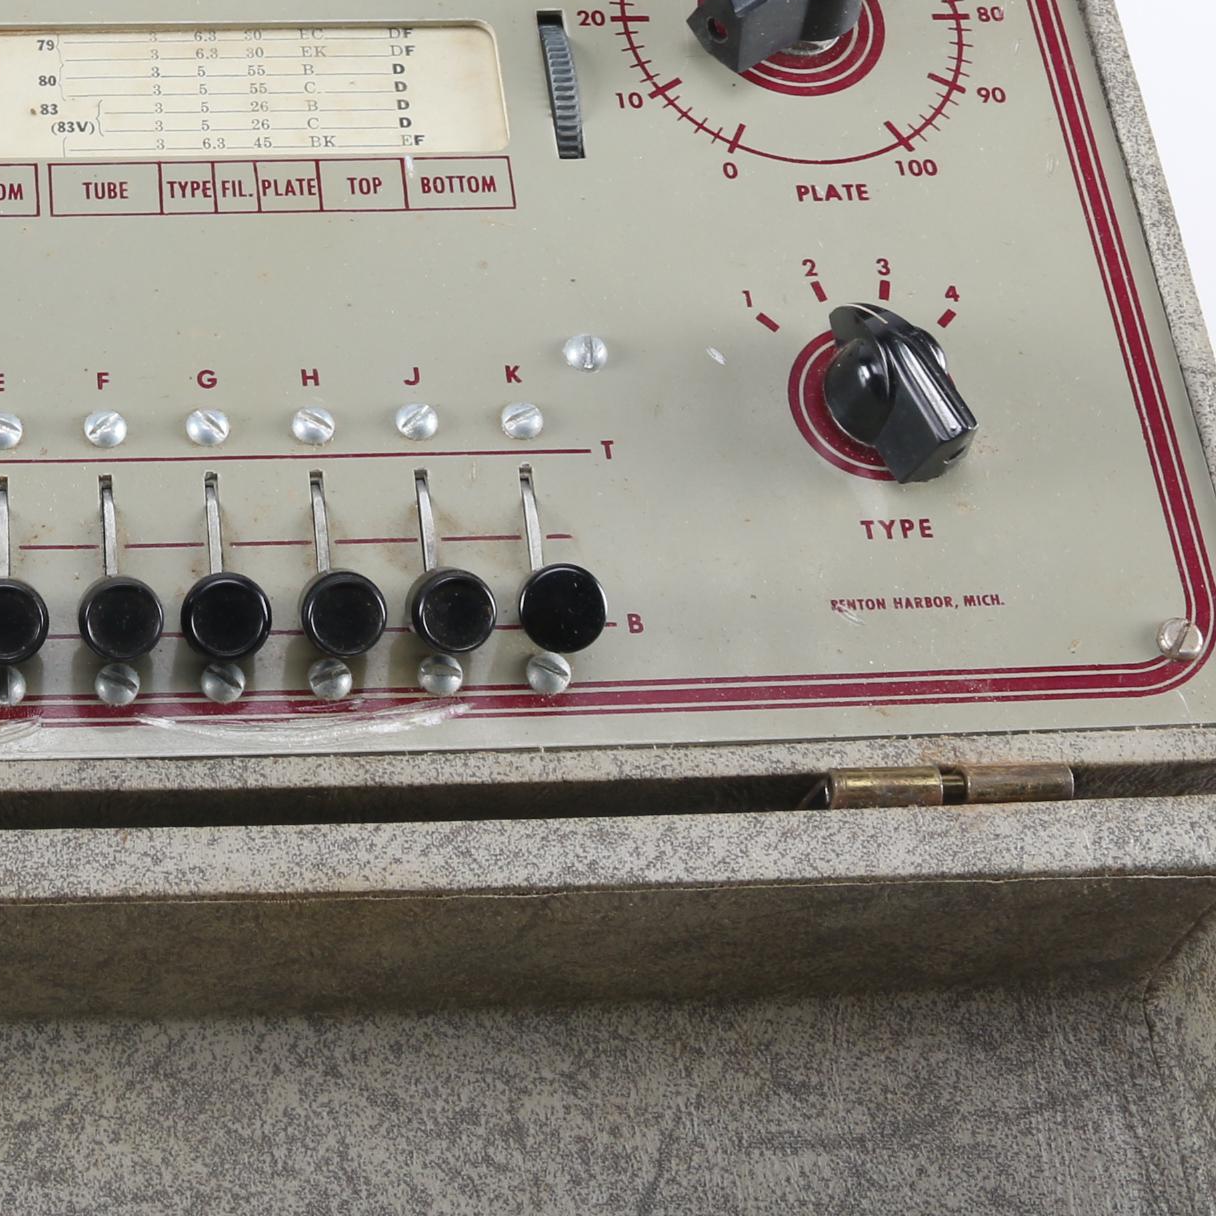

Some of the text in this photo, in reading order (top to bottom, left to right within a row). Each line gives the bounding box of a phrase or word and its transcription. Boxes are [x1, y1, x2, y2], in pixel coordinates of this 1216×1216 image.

[577, 10, 605, 26] 20
[977, 7, 1003, 22] 80
[36, 40, 55, 51] 79
[150, 45, 415, 60] 3 6.3 30 EK DF
[151, 64, 405, 78] 3 5 55 B D
[38, 76, 57, 86] 80
[616, 92, 644, 108] 10
[977, 87, 1006, 103] 90
[40, 104, 59, 115] 83
[154, 100, 410, 113] 3 5 26 B D
[50, 119, 96, 136] (83V)
[156, 135, 426, 150] 3 6.3 45 BK EF
[723, 162, 738, 179] 0
[895, 159, 937, 176] 100
[83, 176, 496, 199] TUBE TYPE FIL. PLATE TOP BOTTOM
[796, 184, 869, 201] PLATE
[802, 259, 818, 276] 2
[876, 259, 890, 275] 3
[742, 291, 752, 307] 1
[945, 286, 960, 302] 4
[97, 372, 109, 390] F
[197, 370, 217, 389] G
[301, 369, 319, 386] H
[404, 367, 420, 385] J
[505, 365, 521, 383] K
[601, 440, 613, 459] T
[860, 519, 933, 539] TYPE
[894, 596, 958, 609] HARBOR,
[964, 595, 1004, 606] MICH.
[628, 614, 643, 633] B
